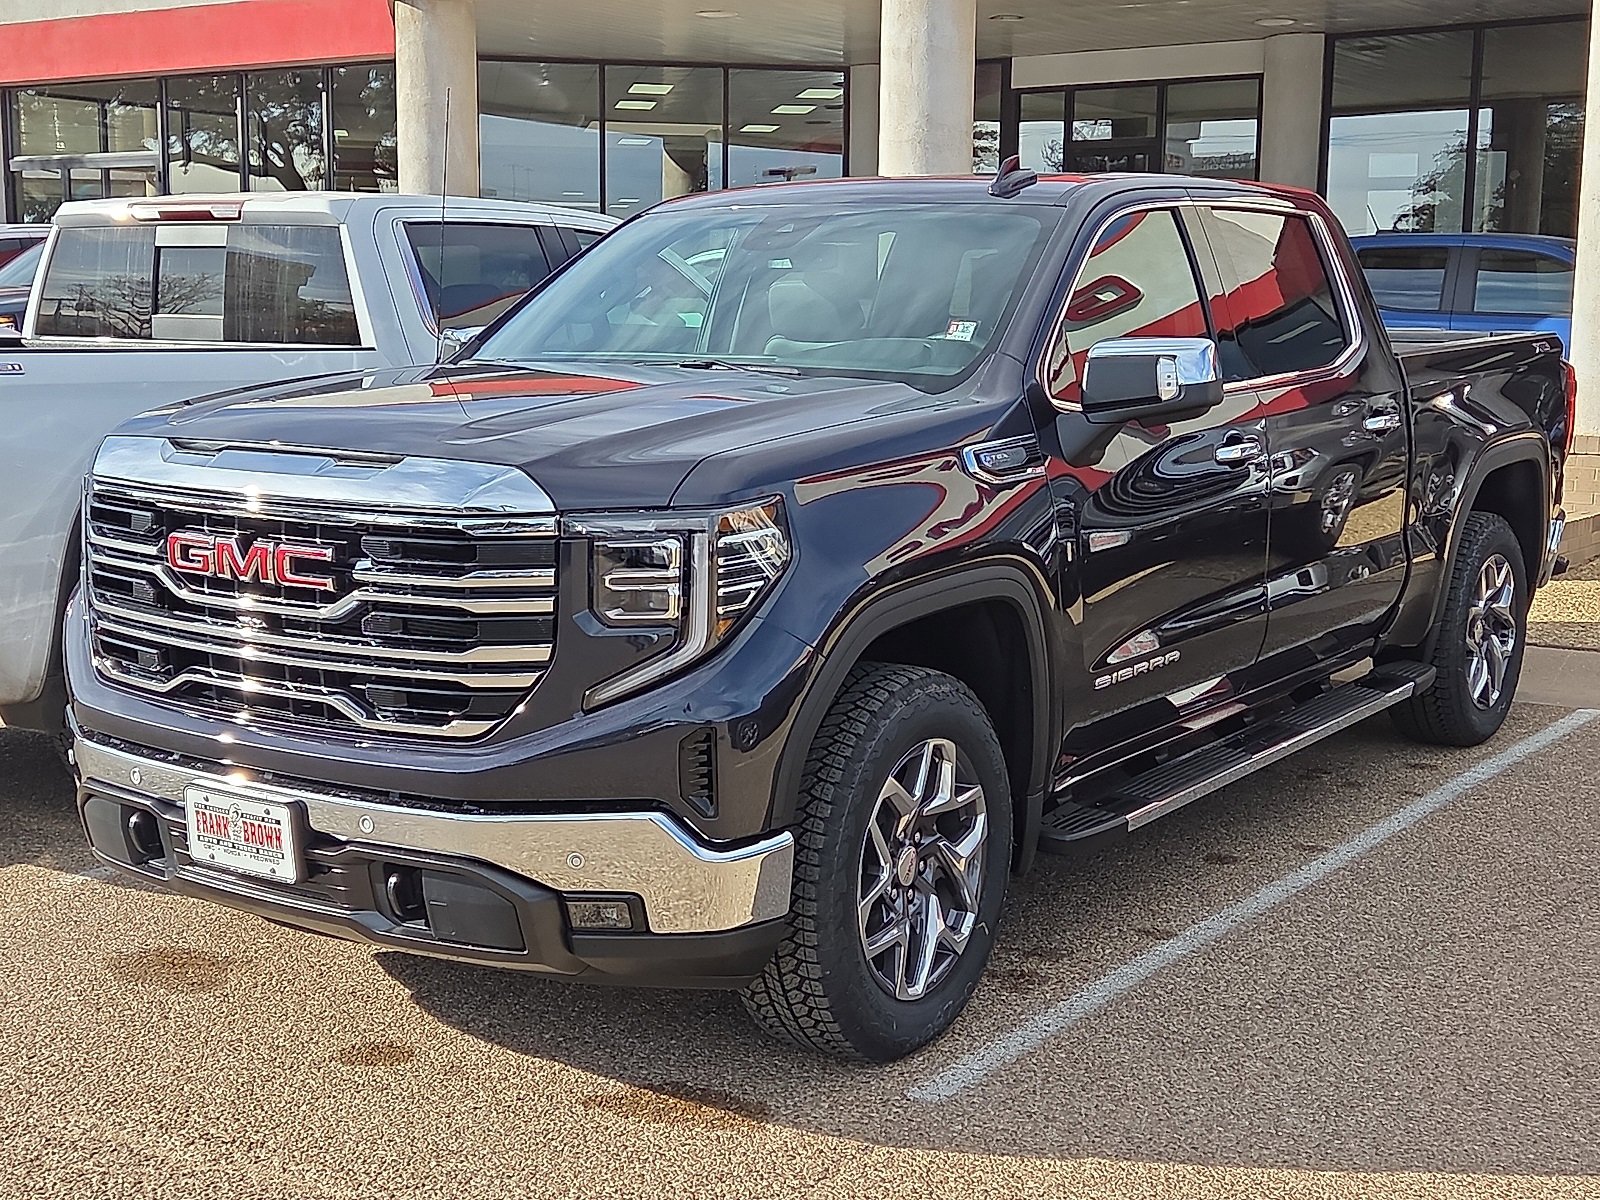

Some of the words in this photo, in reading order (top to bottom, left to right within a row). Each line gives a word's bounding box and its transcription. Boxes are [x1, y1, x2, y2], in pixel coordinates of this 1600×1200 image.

[168, 532, 337, 593] GMC
[1093, 650, 1181, 690] SIERRA
[195, 810, 231, 840] FRANK
[242, 820, 283, 851] BROWN
[199, 836, 218, 844] AUTO
[219, 839, 234, 848] AND
[234, 843, 258, 854] TRUCK
